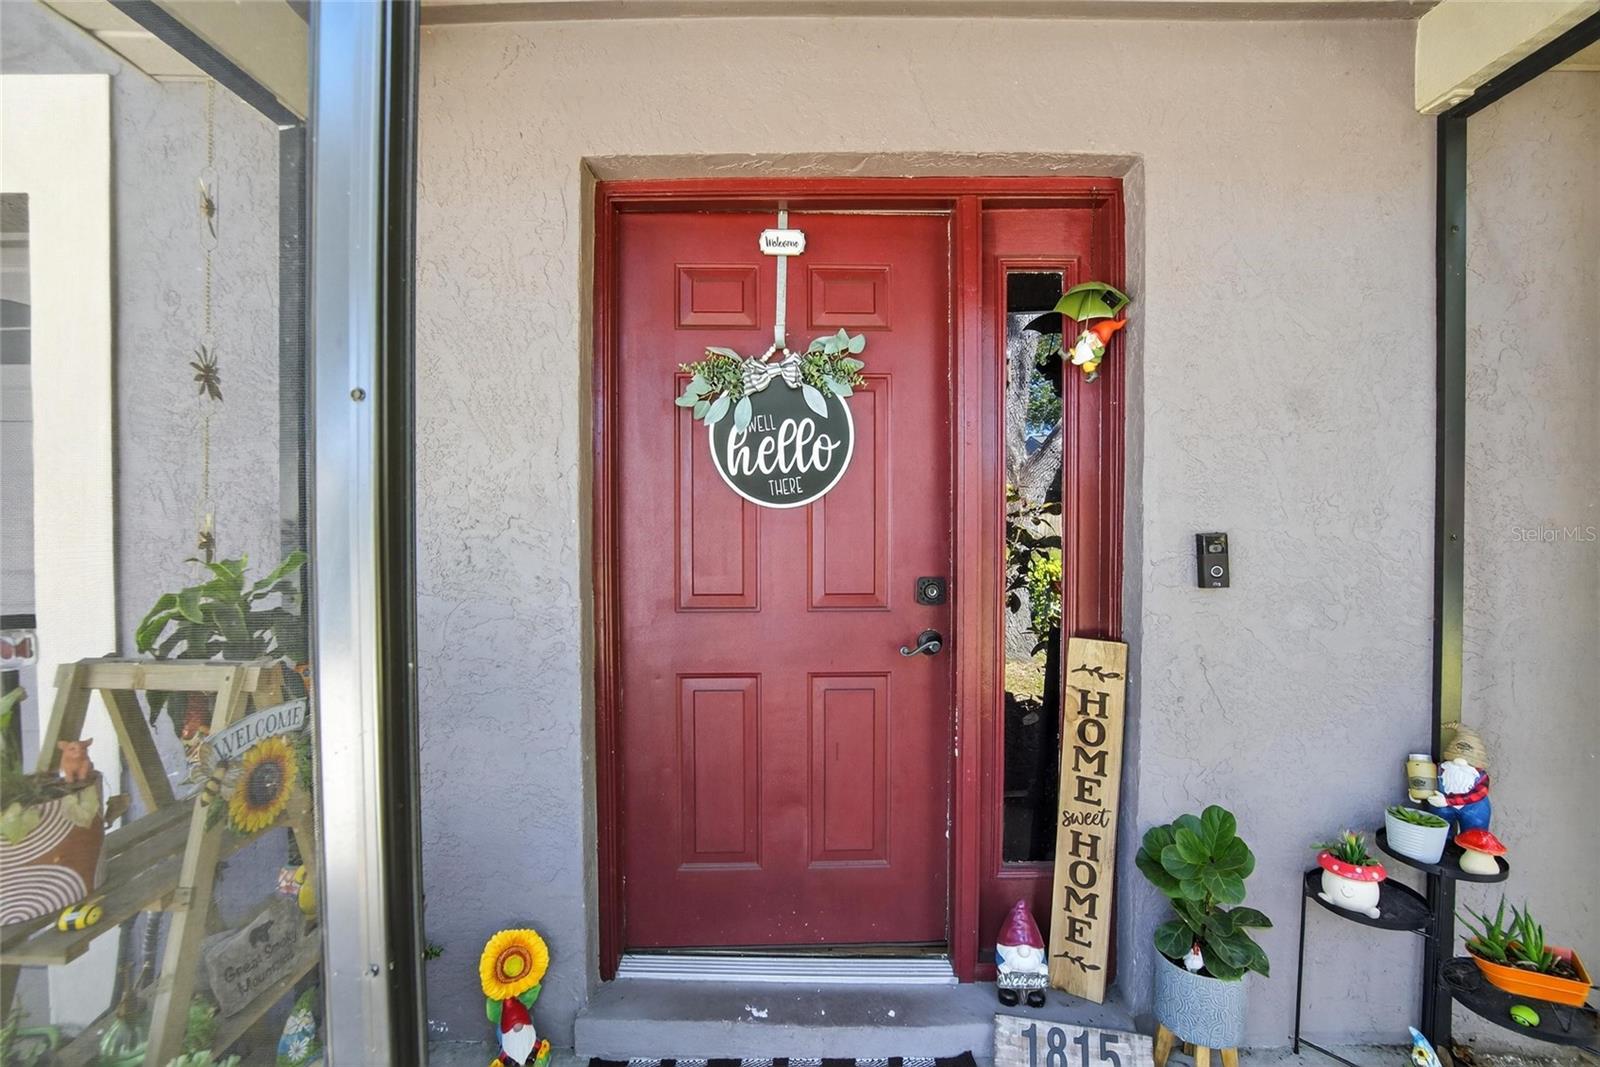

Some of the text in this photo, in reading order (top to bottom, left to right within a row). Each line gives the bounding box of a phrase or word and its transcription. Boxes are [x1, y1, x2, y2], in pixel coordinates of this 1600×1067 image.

[727, 417, 841, 477] hello
[747, 413, 777, 433] WELL
[768, 476, 804, 496] THERE
[213, 705, 302, 761] WELCOME
[1071, 688, 1110, 806] HOME
[1061, 807, 1112, 828] sweet
[1063, 829, 1102, 949] HOME
[1021, 1023, 1122, 1067] 1815
